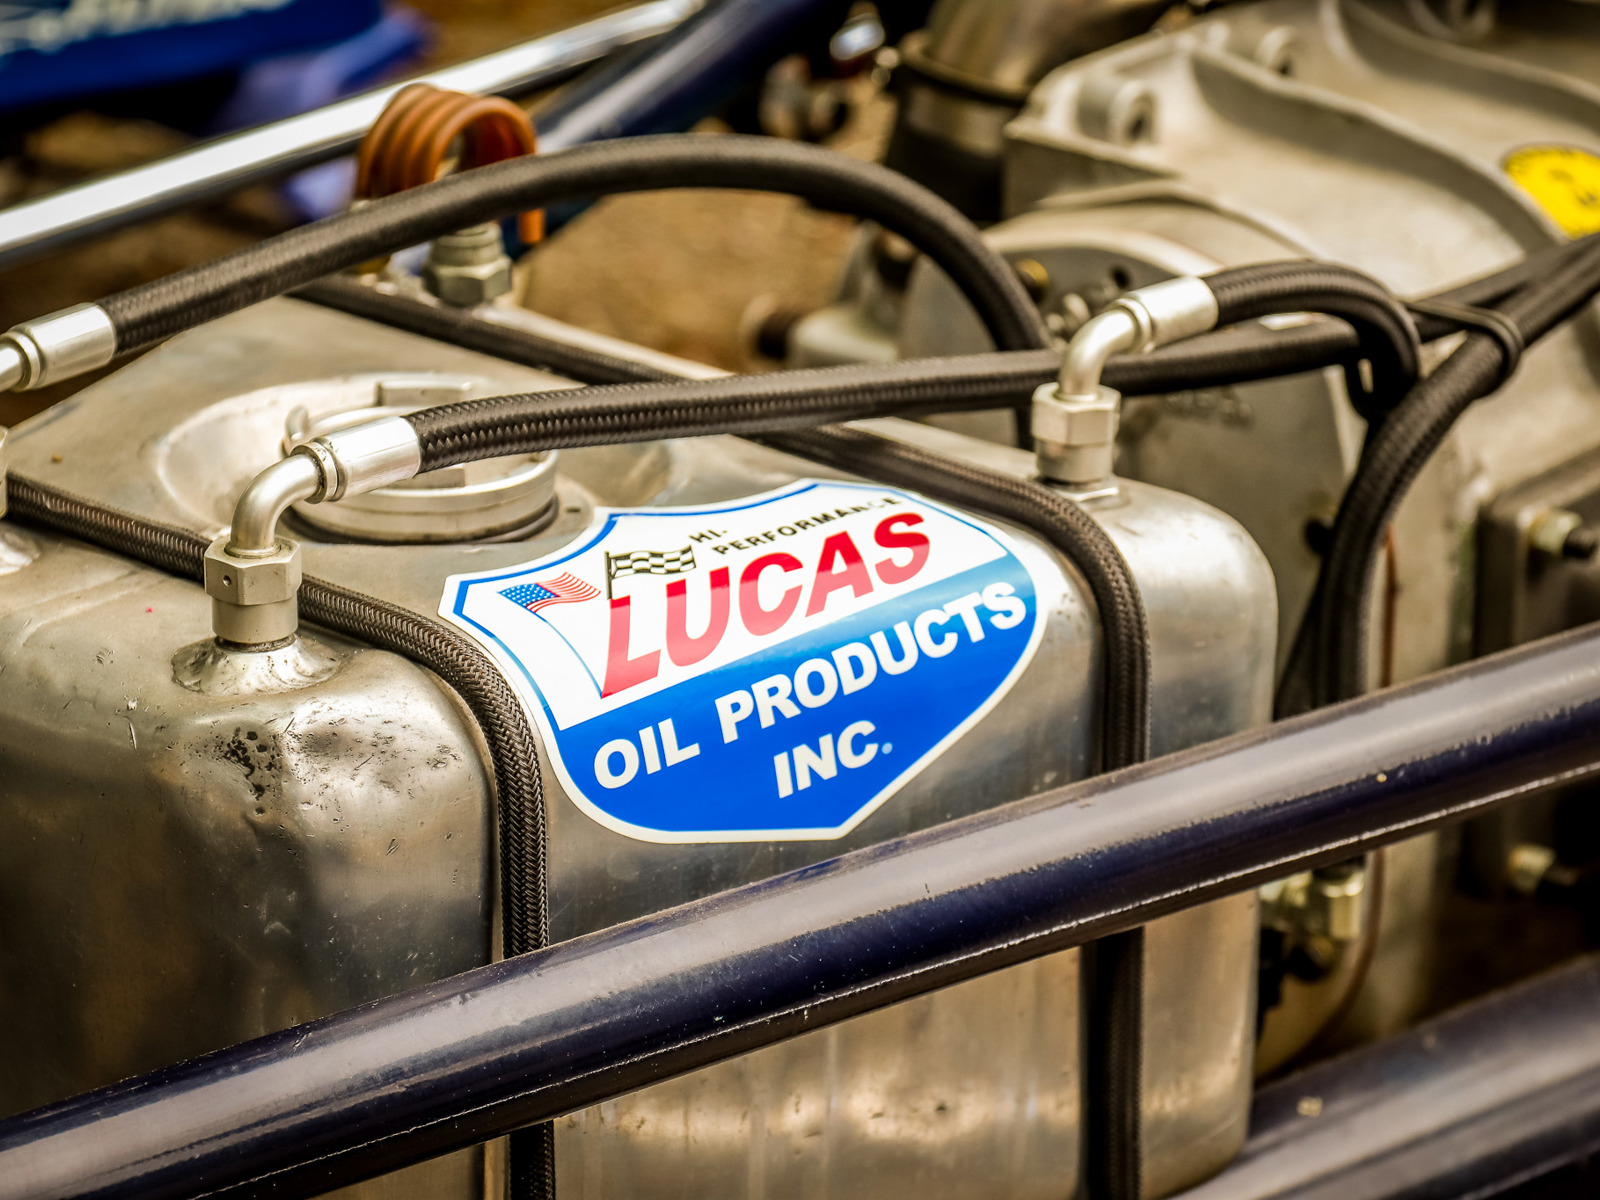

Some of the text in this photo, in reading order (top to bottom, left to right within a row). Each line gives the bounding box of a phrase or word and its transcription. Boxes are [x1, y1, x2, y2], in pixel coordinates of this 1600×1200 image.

[594, 582, 1027, 789] OIL PRODUCTS
[600, 511, 931, 699] LUCAS
[772, 720, 893, 798] INC.
